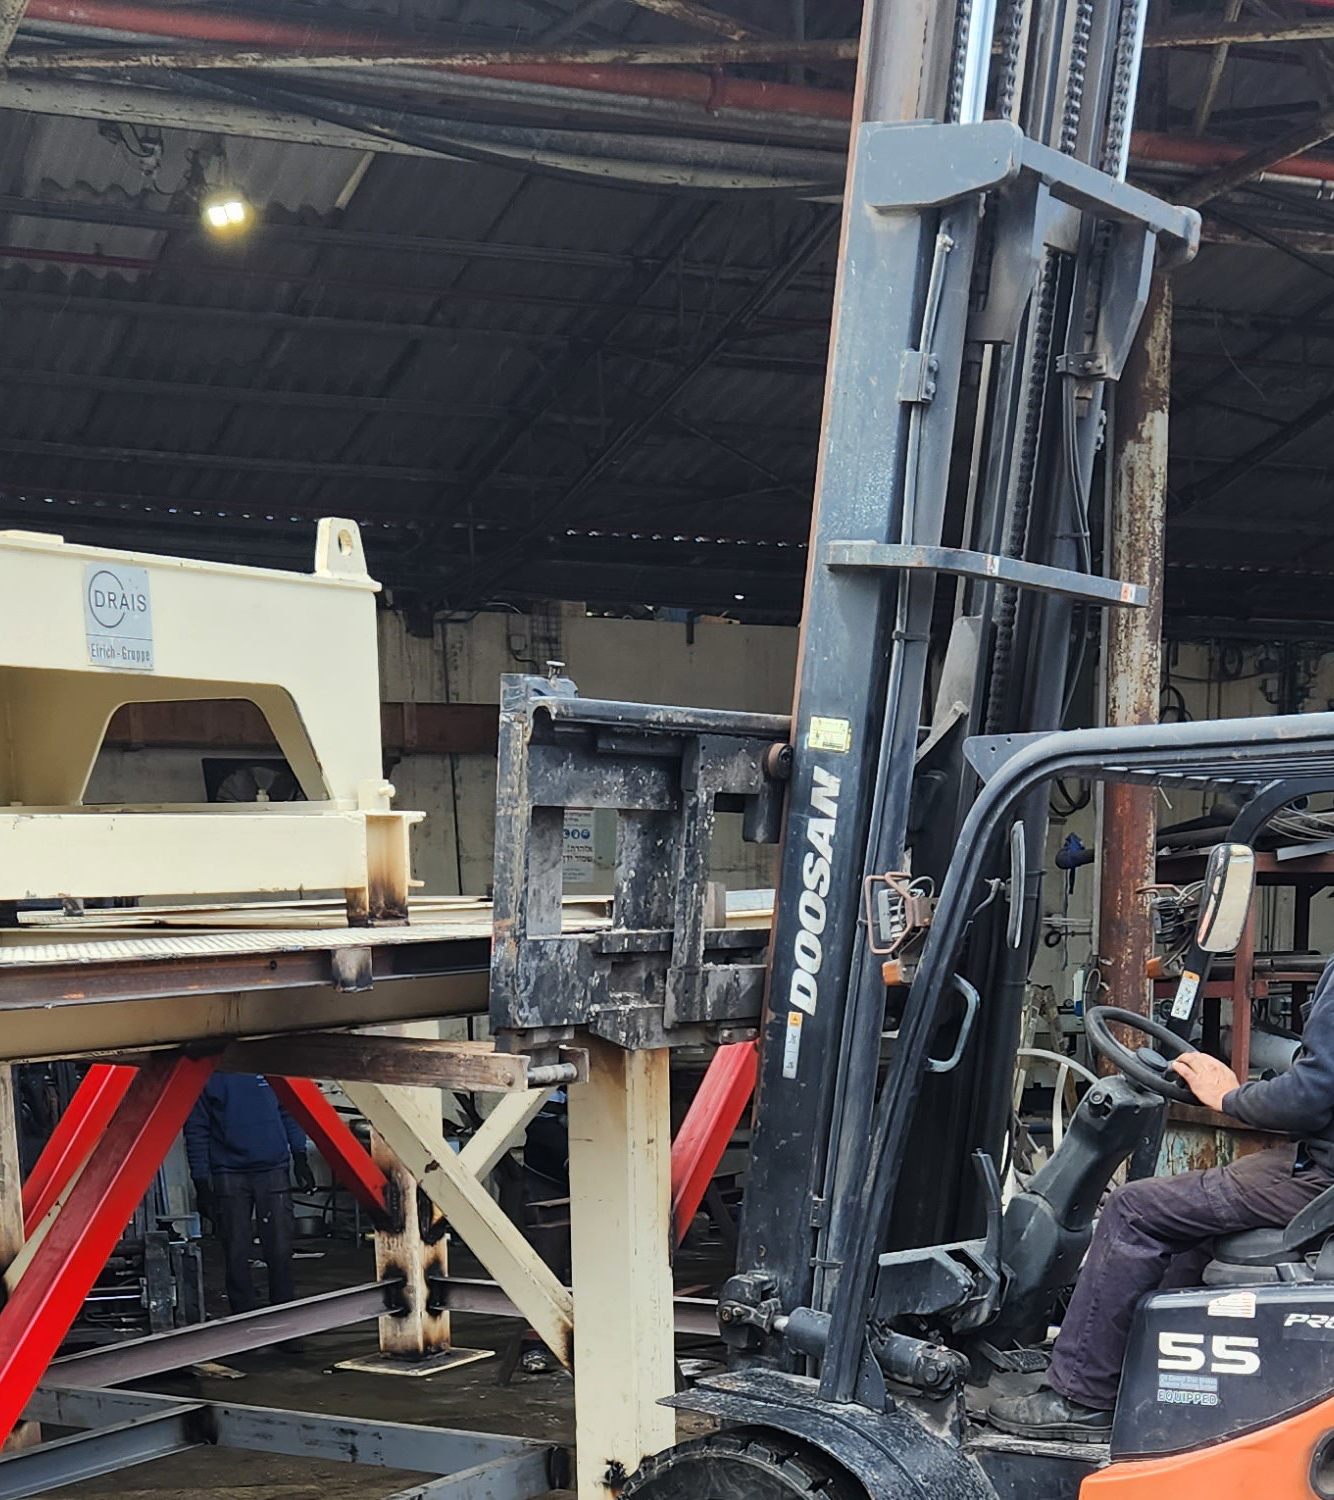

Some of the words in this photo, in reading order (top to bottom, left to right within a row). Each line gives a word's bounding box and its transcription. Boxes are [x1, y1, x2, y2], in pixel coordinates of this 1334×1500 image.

[94, 590, 147, 612] DRAIS
[789, 766, 842, 1017] DOOSAN
[1158, 1332, 1261, 1375] 55
[1157, 1388, 1218, 1406] EQUIPPED
